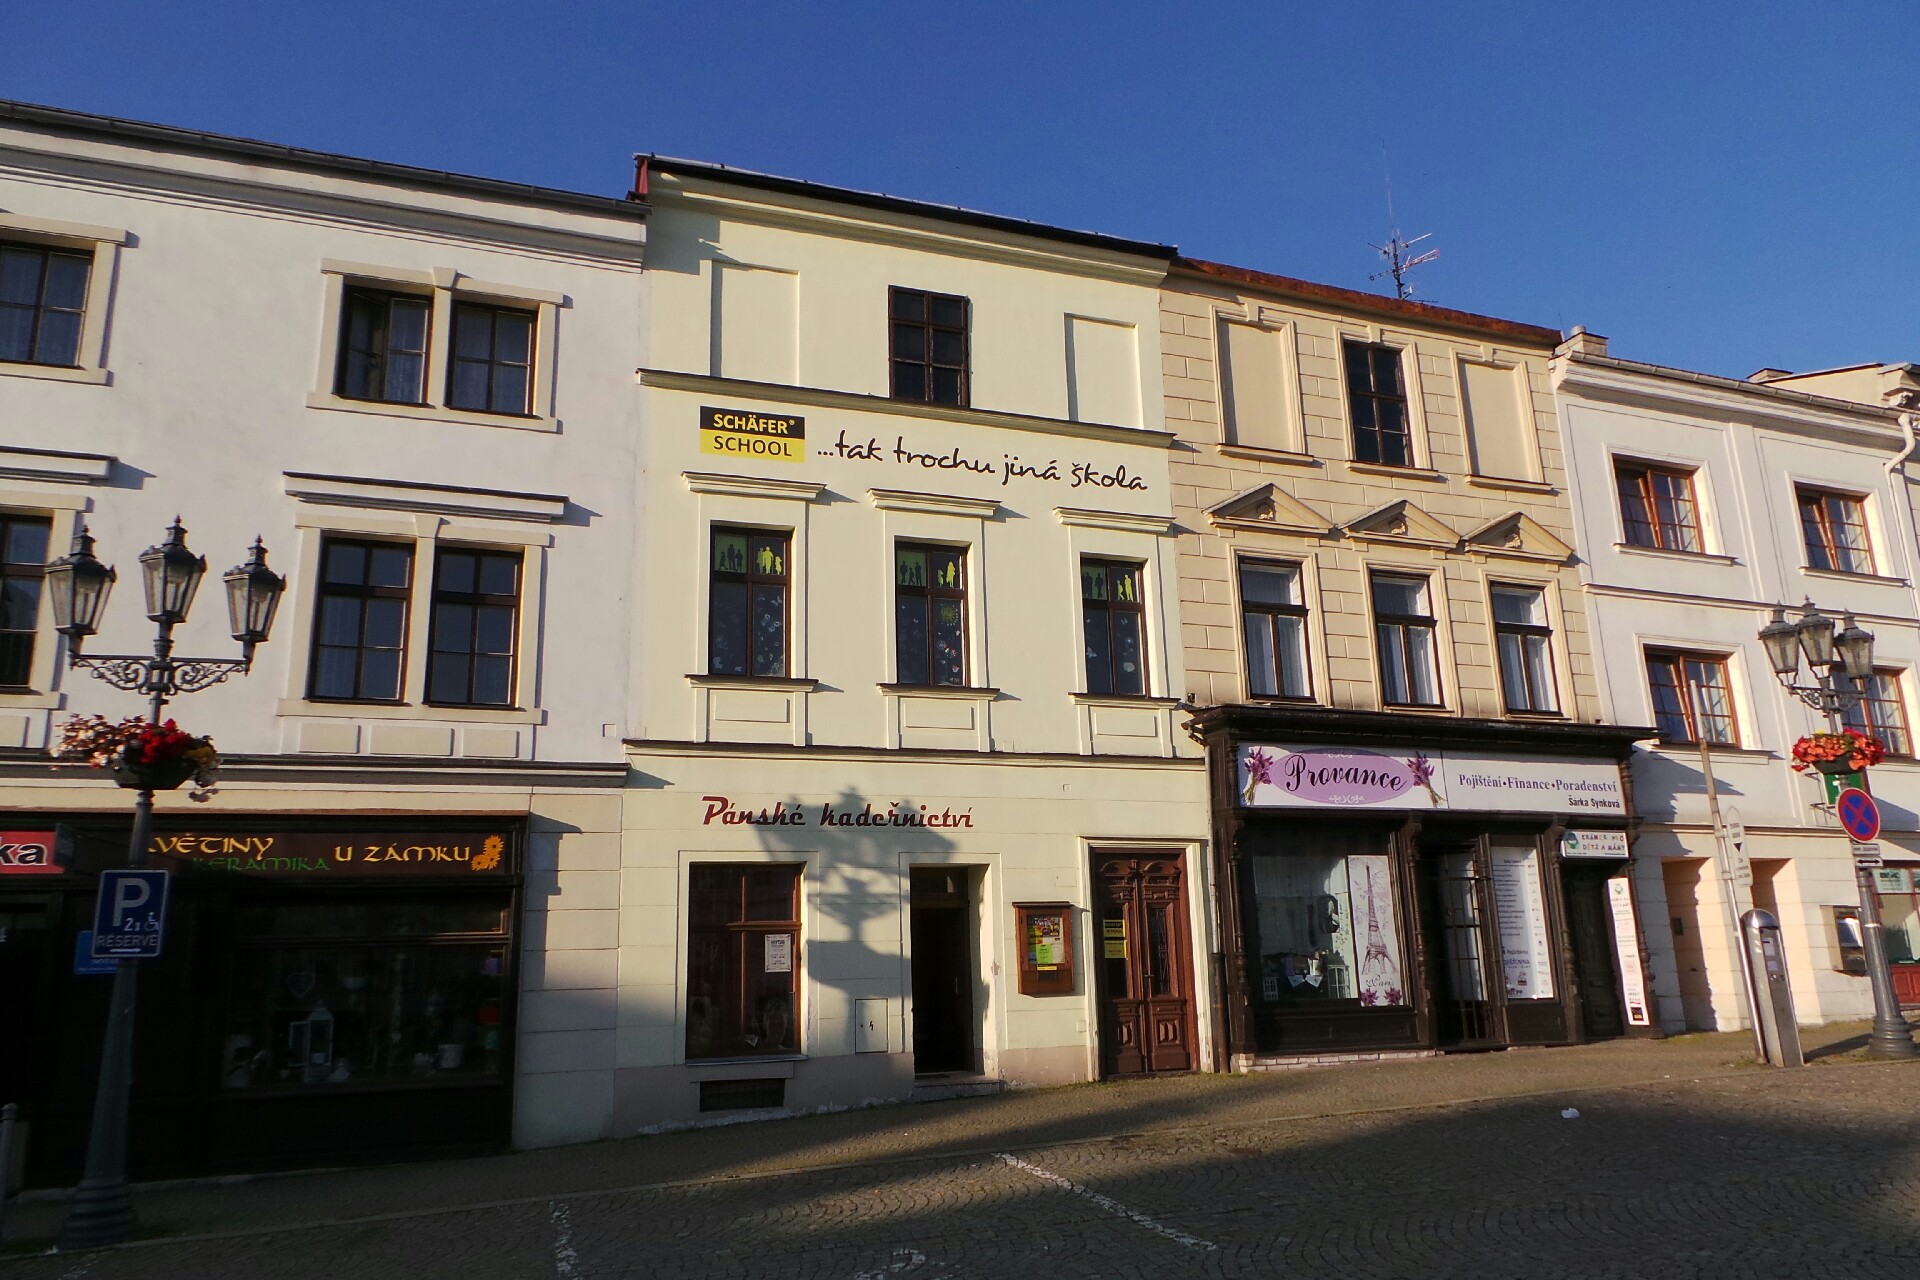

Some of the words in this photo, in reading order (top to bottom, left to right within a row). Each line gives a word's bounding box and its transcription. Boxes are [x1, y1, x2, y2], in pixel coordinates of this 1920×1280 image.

[713, 436, 792, 457] SCHOOL
[893, 435, 995, 474] trochu
[1002, 453, 1061, 485] jiná
[1071, 462, 1148, 490] škola
[1284, 753, 1408, 792] Provance
[1507, 777, 1550, 790] Finance
[701, 795, 806, 826] Pánské
[820, 801, 974, 828] kadeřnictví
[147, 833, 274, 861] VĚTINY
[334, 845, 353, 862] U
[362, 843, 472, 863] ZÁMKU
[192, 856, 330, 872] KERAMIKA
[112, 877, 151, 927] P
